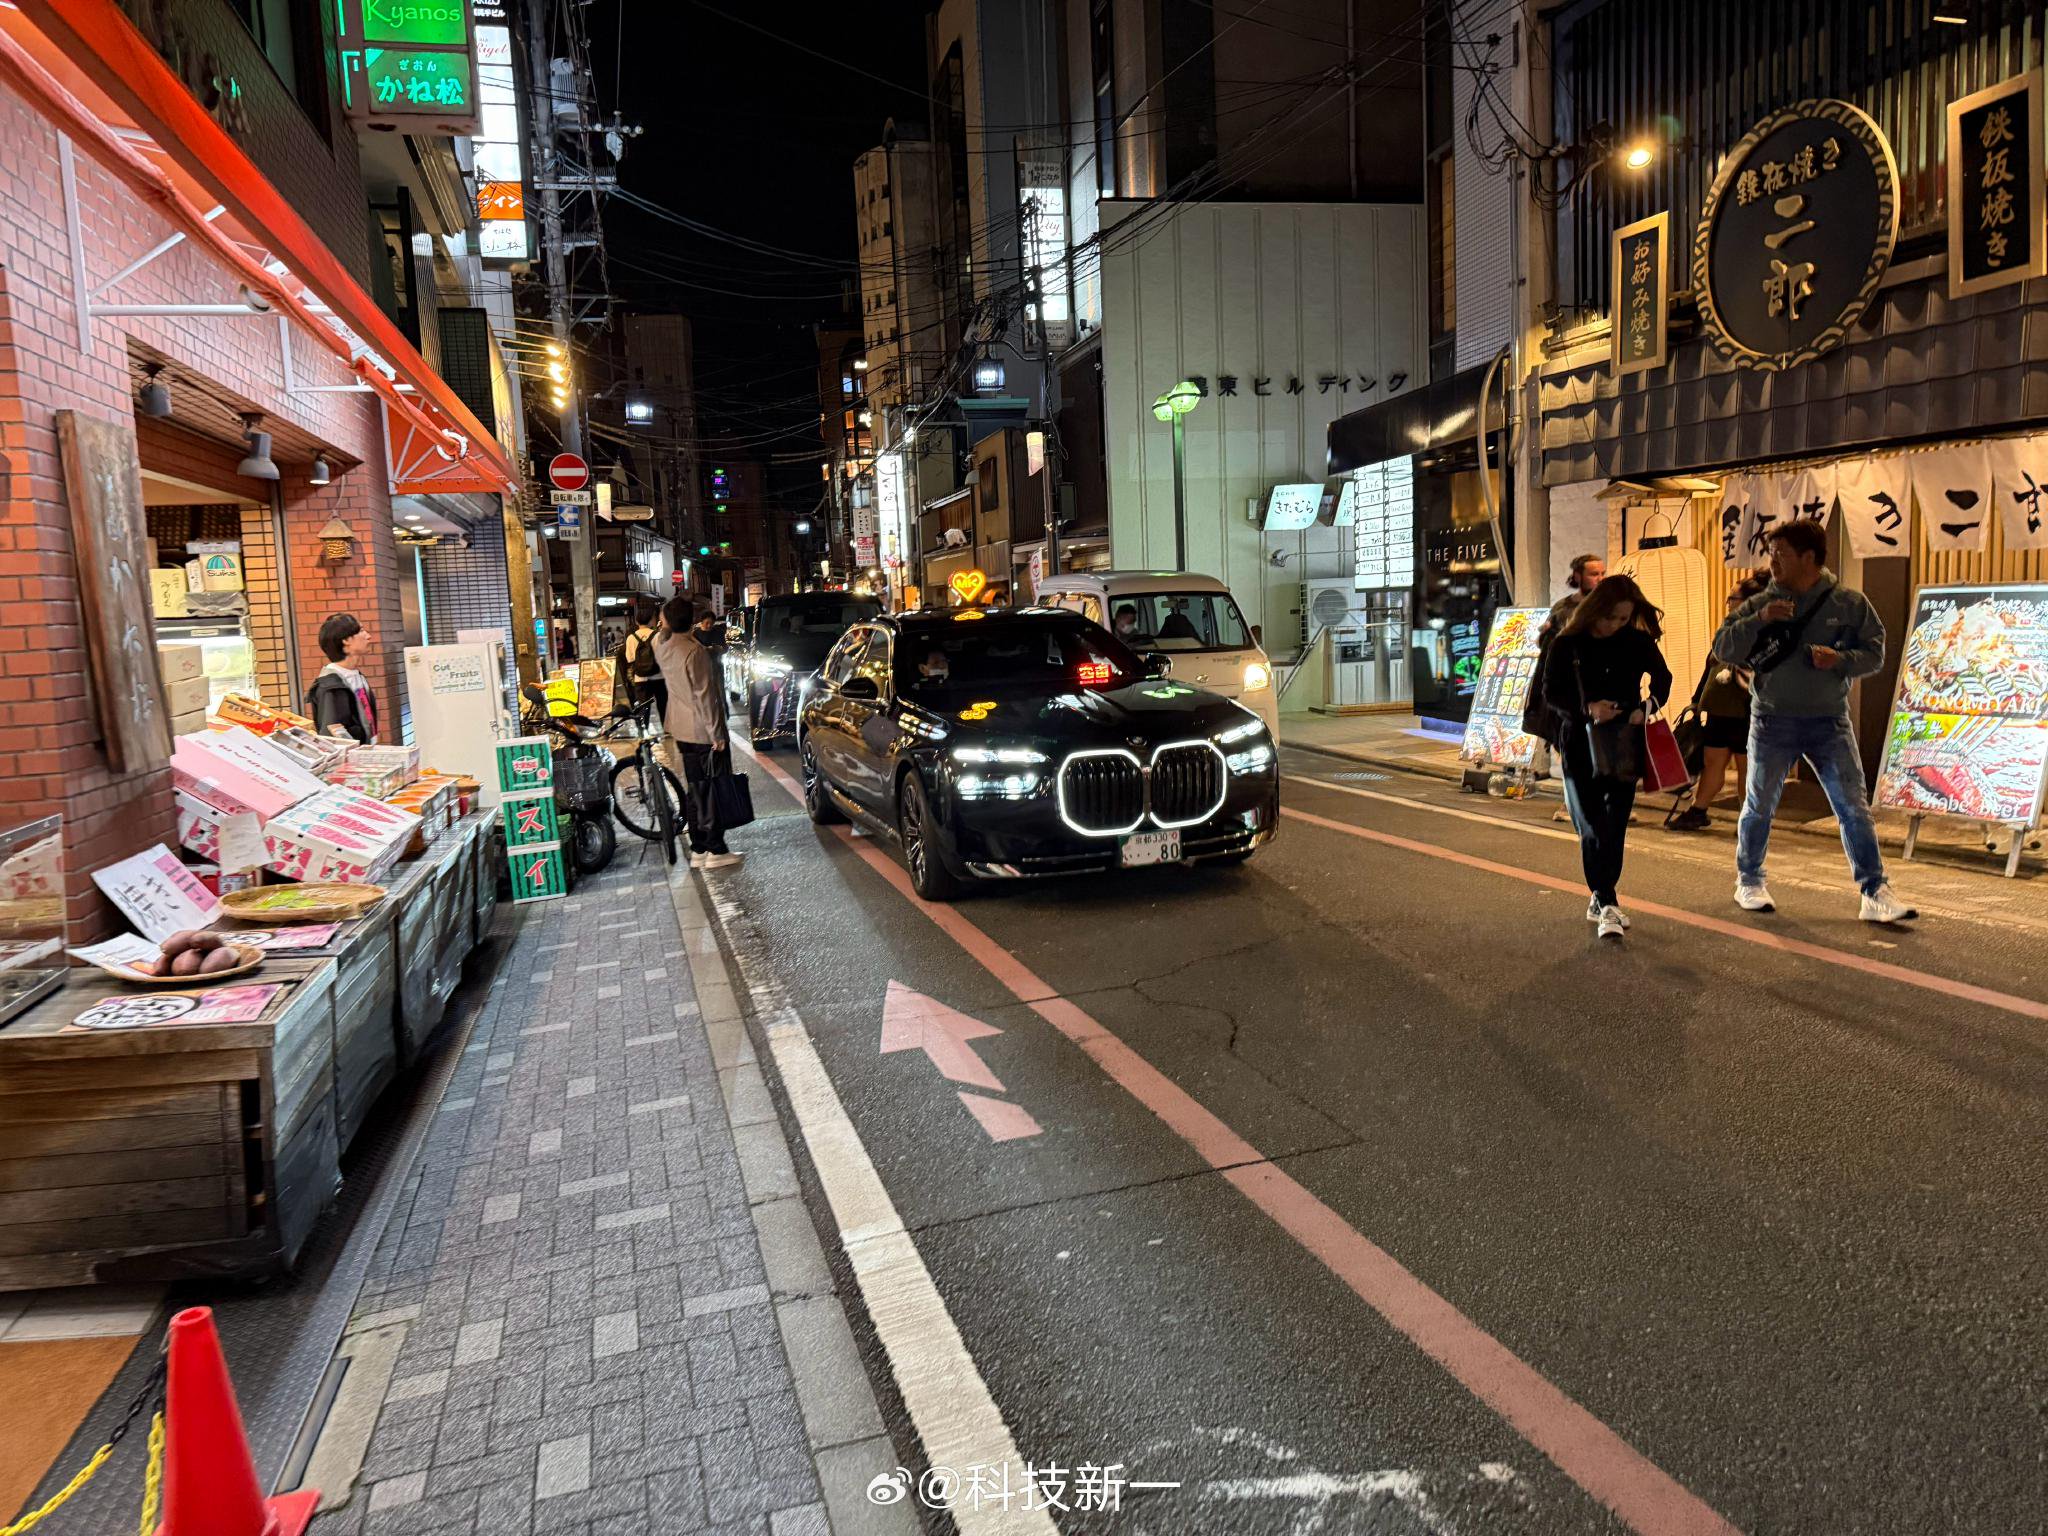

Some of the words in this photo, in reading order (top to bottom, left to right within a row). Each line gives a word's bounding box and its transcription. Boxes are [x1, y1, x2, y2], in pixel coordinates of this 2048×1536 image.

[367, 0, 461, 27] Kyanos
[399, 59, 437, 72] ぎおん
[376, 75, 465, 105] かね松
[1980, 104, 2015, 268] 鉄板焼き
[1630, 239, 1652, 357] お好み焼き
[1274, 500, 1313, 515] きたむら
[1427, 548, 1449, 563] THE
[1457, 543, 1486, 560] FIVE
[955, 578, 978, 588] MK
[433, 664, 451, 672] Cut
[450, 669, 479, 679] Fruits
[516, 806, 546, 834] ス
[1161, 842, 1179, 860] 80
[524, 858, 549, 886] イ
